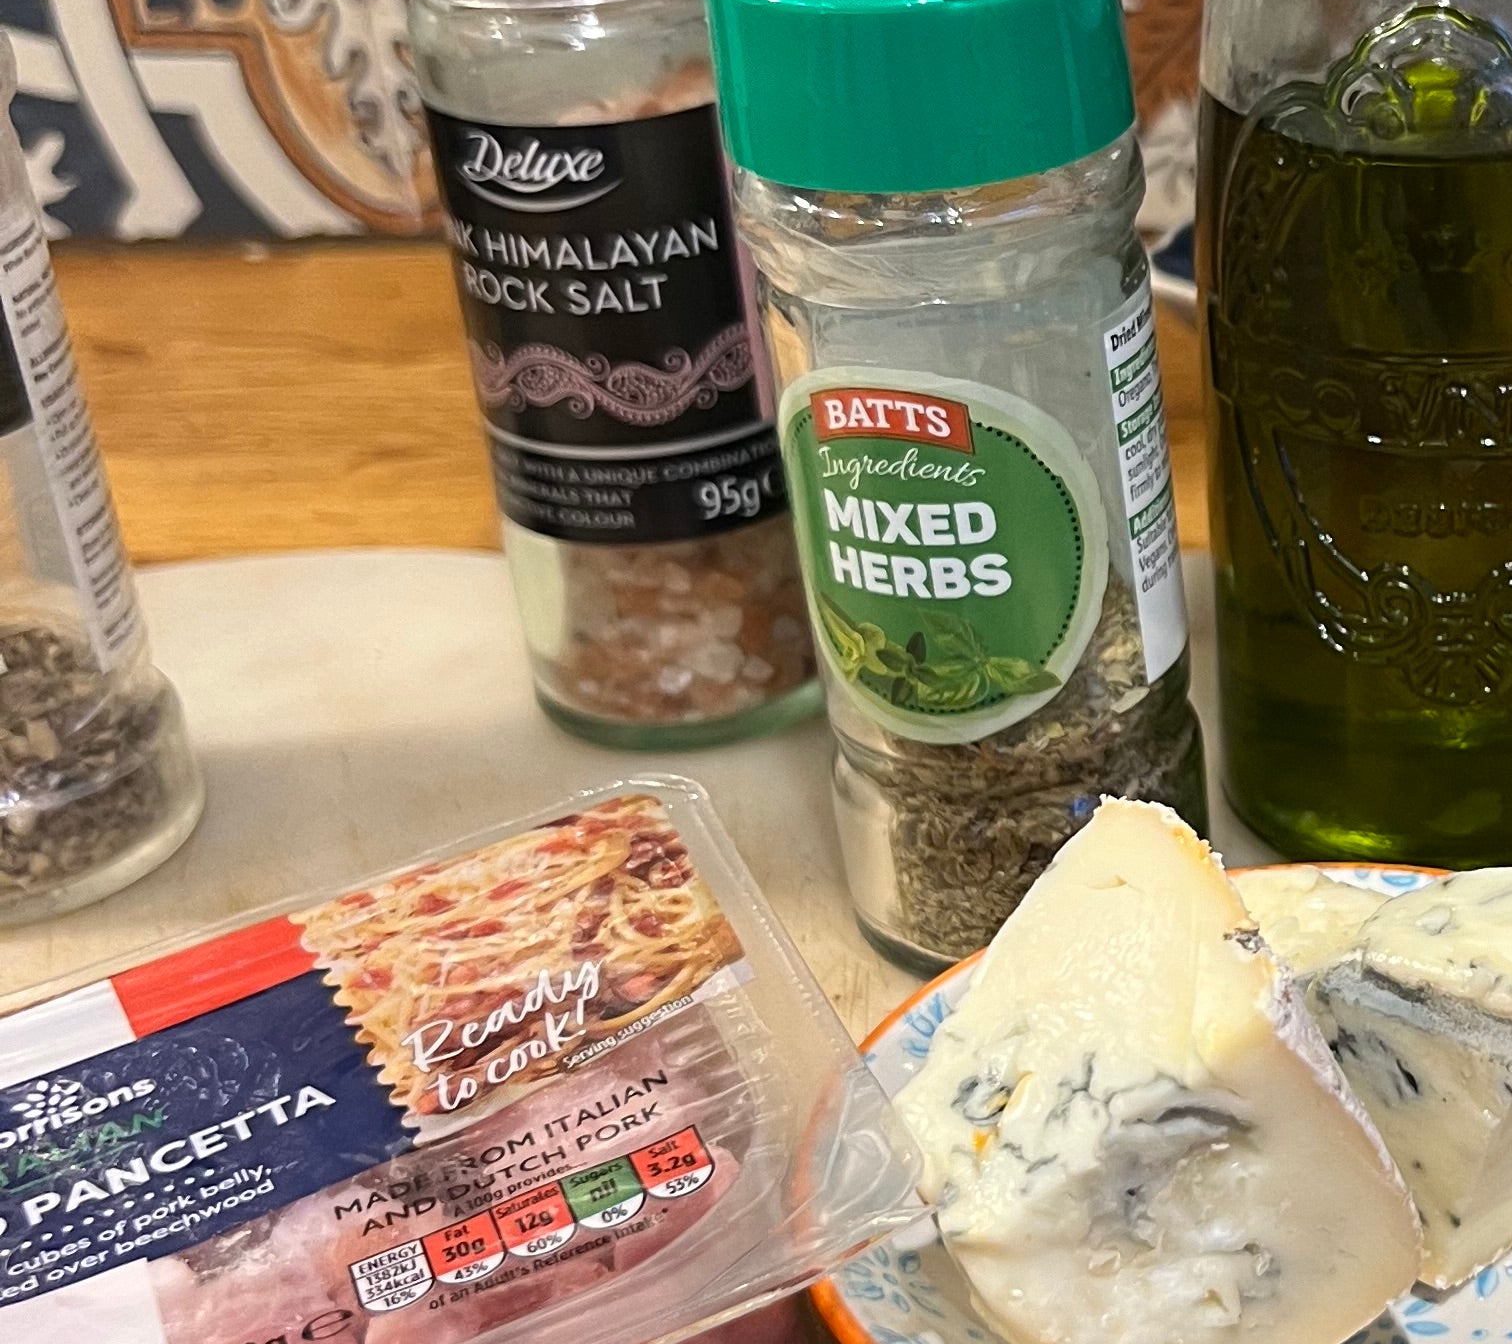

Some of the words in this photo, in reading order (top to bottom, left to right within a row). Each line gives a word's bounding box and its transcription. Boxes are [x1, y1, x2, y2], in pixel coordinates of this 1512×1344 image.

[462, 133, 606, 193] Deluxe
[483, 216, 719, 271] HIMALAYAN
[462, 259, 556, 315] ROCK
[568, 272, 669, 316] SALT
[823, 397, 952, 439] BATTS
[818, 445, 987, 491] Ingredients
[699, 477, 761, 521] 95g
[824, 487, 998, 547] MIXED
[829, 539, 1013, 600] HERBS
[401, 959, 604, 1074] Ready
[562, 1032, 617, 1070] Serving
[617, 992, 694, 1043] suggestion
[425, 1071, 479, 1111] to
[0, 1077, 157, 1150] orrisons
[22, 1084, 337, 1227] PANCETTA
[333, 1170, 431, 1222] MADE
[441, 1130, 535, 1181] FROM
[543, 1068, 670, 1140] ITALIAN
[647, 1154, 698, 1177] 3.2g
[648, 1140, 681, 1159] Salt
[362, 1196, 437, 1238] AND
[447, 1144, 567, 1202] DUTCH
[576, 1100, 665, 1154] PORK
[570, 1161, 624, 1188] Sugars
[665, 1173, 700, 1194] 53%
[8, 1238, 92, 1276] cubes
[98, 1219, 128, 1244] of
[132, 1194, 197, 1232] pork
[200, 1163, 274, 1200] belly,
[496, 1186, 560, 1219] Saturates
[515, 1208, 555, 1233] 12g
[601, 1204, 628, 1224] 0%
[46, 1249, 110, 1282] over
[114, 1178, 276, 1257] beechwood
[441, 1236, 487, 1263] 30g
[443, 1224, 470, 1242] Fat
[527, 1234, 563, 1254] 60%
[358, 1244, 419, 1275] ENERGY
[429, 1294, 446, 1311] of
[533, 1234, 611, 1273] Reference
[454, 1261, 489, 1281] 43%
[384, 1289, 417, 1308] 16%
